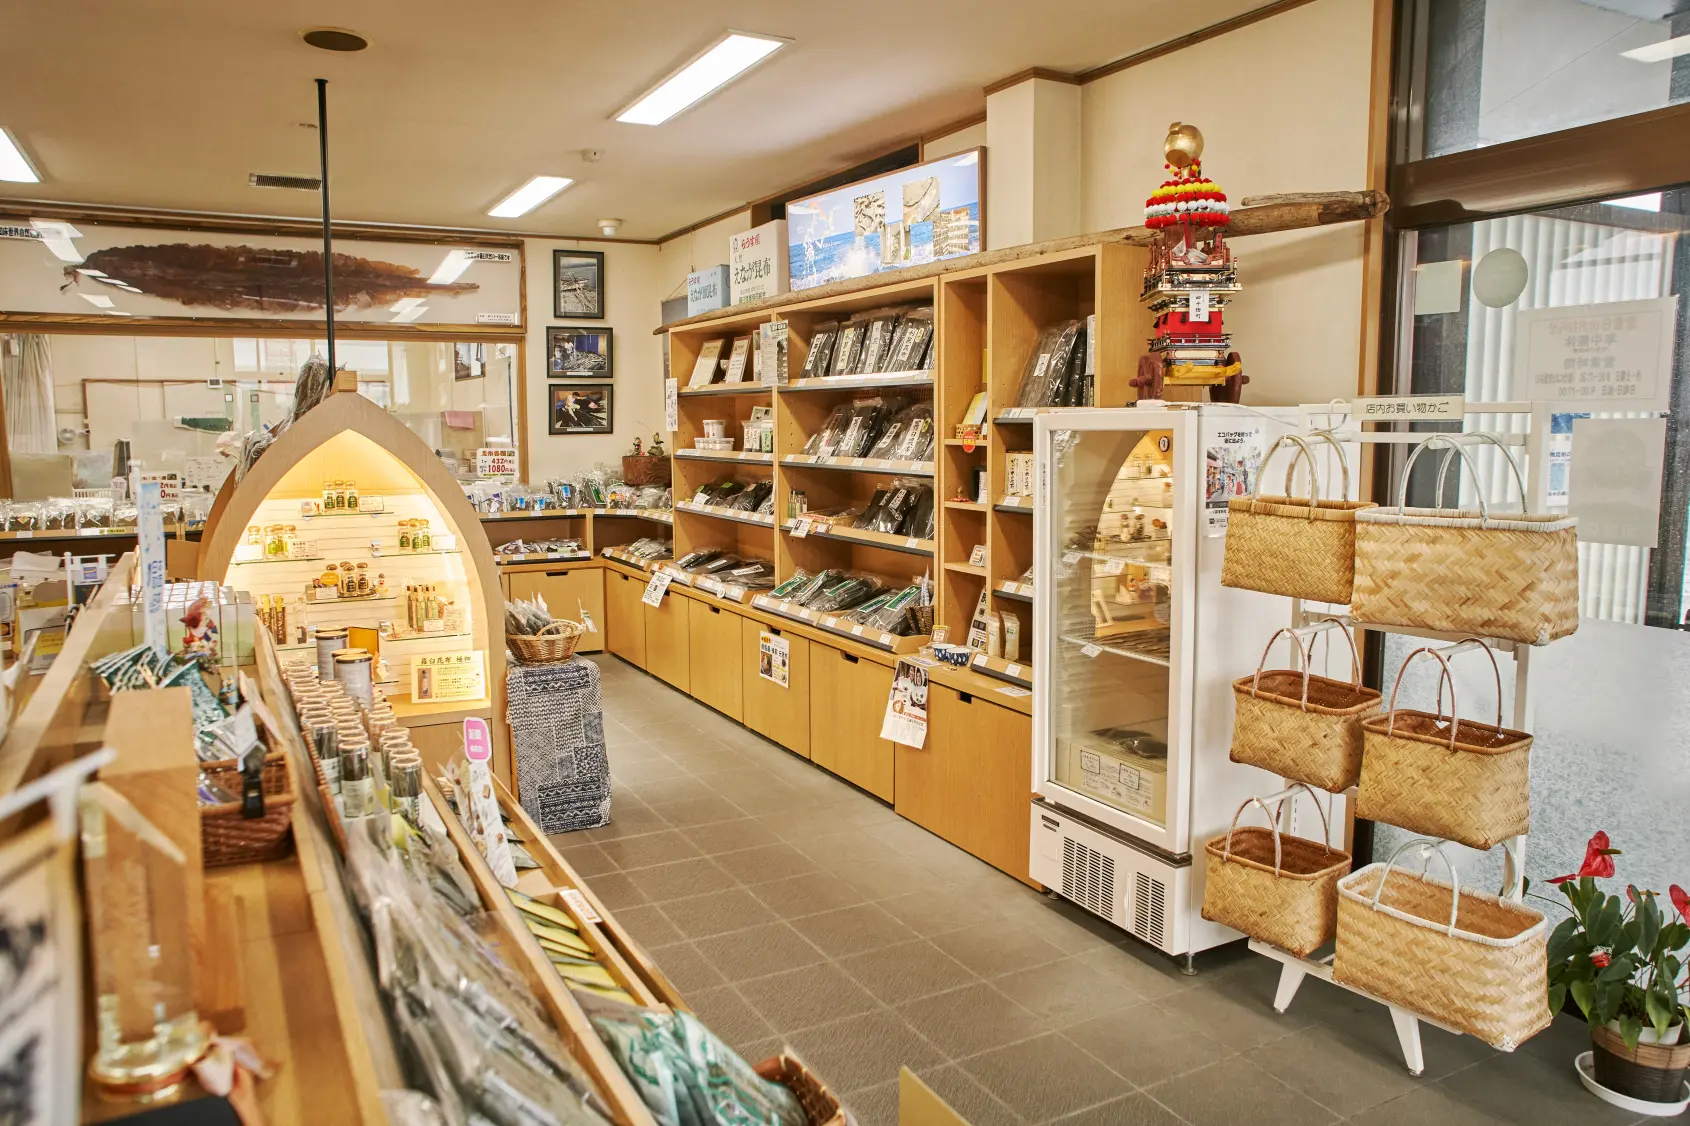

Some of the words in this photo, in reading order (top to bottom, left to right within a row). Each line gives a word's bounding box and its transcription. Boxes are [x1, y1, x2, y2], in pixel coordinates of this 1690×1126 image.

[1366, 401, 1449, 414] 店内お買い物かご
